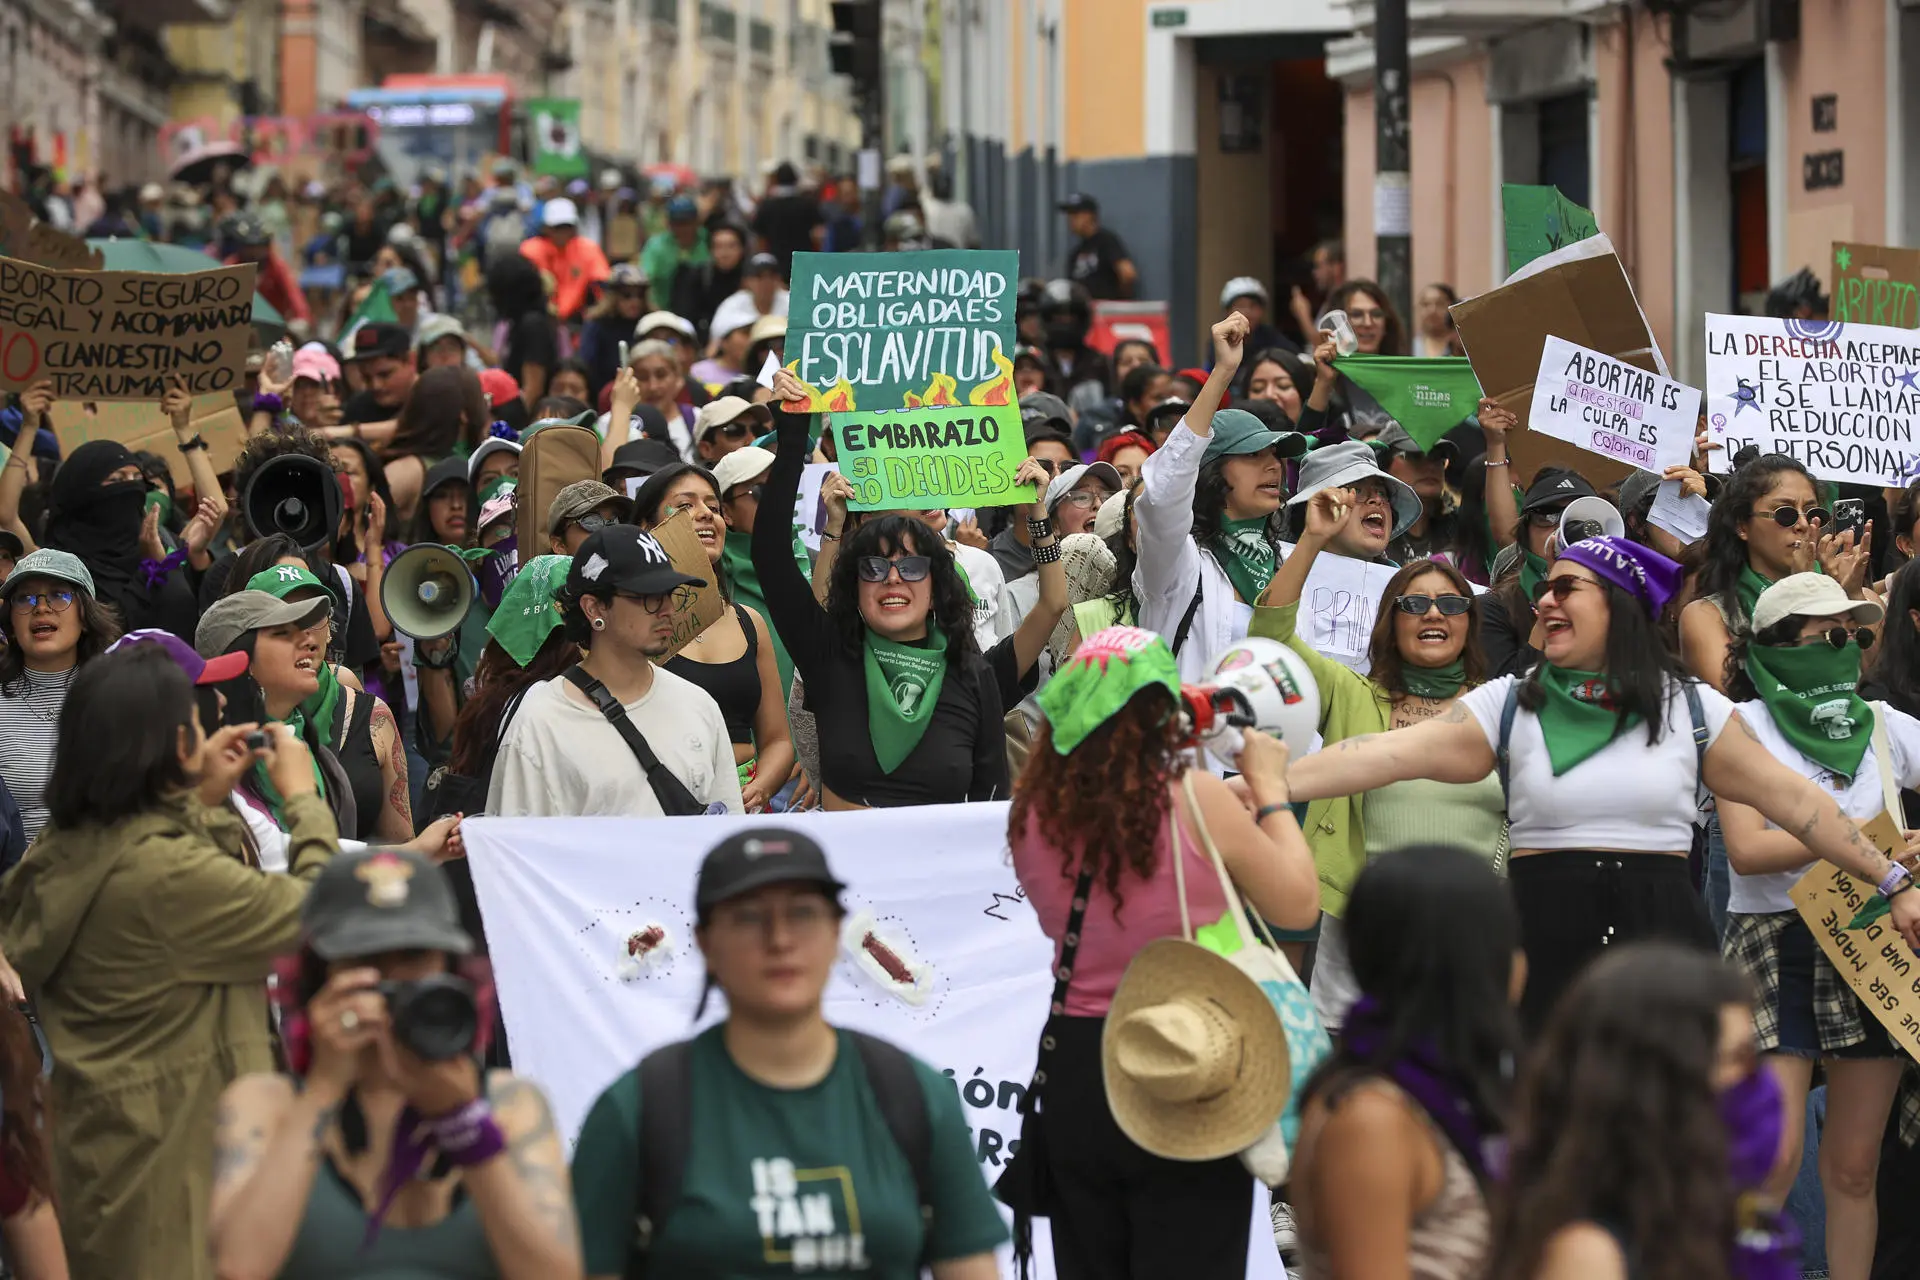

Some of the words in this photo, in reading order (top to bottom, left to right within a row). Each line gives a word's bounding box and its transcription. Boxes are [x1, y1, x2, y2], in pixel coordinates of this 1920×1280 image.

[1, 262, 103, 305] BORTO
[116, 275, 240, 309] SEGURO
[812, 268, 1007, 301] MATERNIDAD
[1835, 276, 1919, 329] ABORTO
[87, 308, 103, 334] Y
[111, 301, 252, 338] ACOMPAÑADO
[0, 326, 40, 383] O
[44, 340, 223, 371] CLANDESTINO
[801, 327, 1004, 388] ESCLAVITUD
[1709, 331, 1738, 356] LA
[1745, 333, 1843, 360] DERECHA
[1564, 351, 1656, 405] ABORTAR
[1661, 383, 1681, 411] ES
[1759, 359, 1788, 382] EL
[1802, 361, 1896, 388] ABORTO
[1568, 381, 1638, 416] ancestral
[1738, 378, 1765, 404] SI
[1775, 381, 1814, 409] SE
[842, 416, 999, 451] EMBARAZO
[1550, 394, 1568, 414] LA
[1582, 405, 1629, 436] CULPA
[1638, 423, 1658, 446] ES
[852, 457, 877, 478] SI
[883, 451, 1010, 499] DECIDES
[1774, 438, 1912, 477] PERSONAL
[1820, 907, 1868, 973] MADRE
[1880, 941, 1910, 977] UNA
[1869, 976, 1900, 1011] SER
